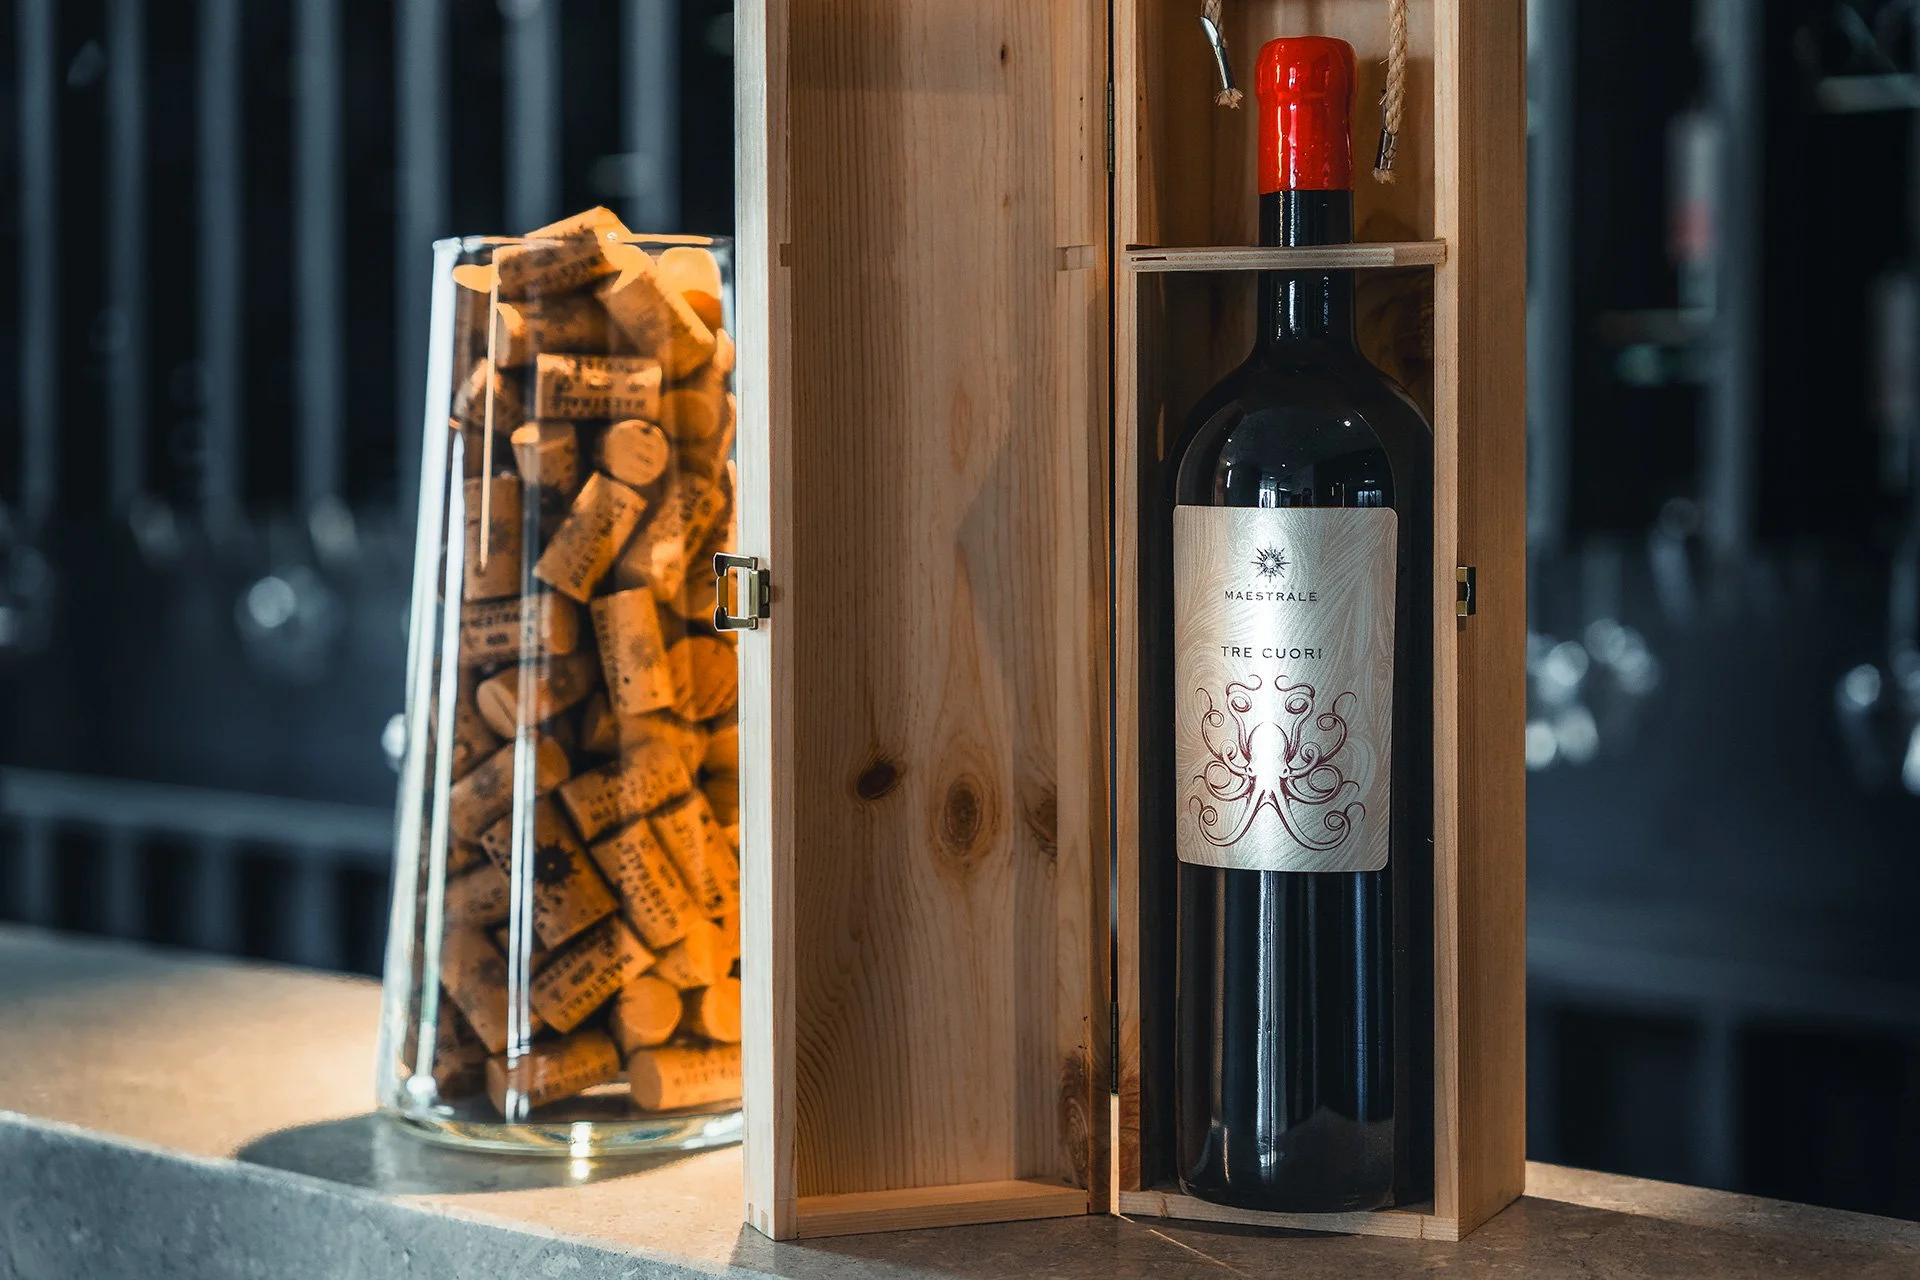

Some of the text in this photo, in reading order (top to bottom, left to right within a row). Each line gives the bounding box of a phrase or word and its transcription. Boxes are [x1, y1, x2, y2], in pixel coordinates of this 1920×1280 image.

[1224, 591, 1318, 601] MAESTRALE
[1221, 646, 1322, 659] TRE CUORI
